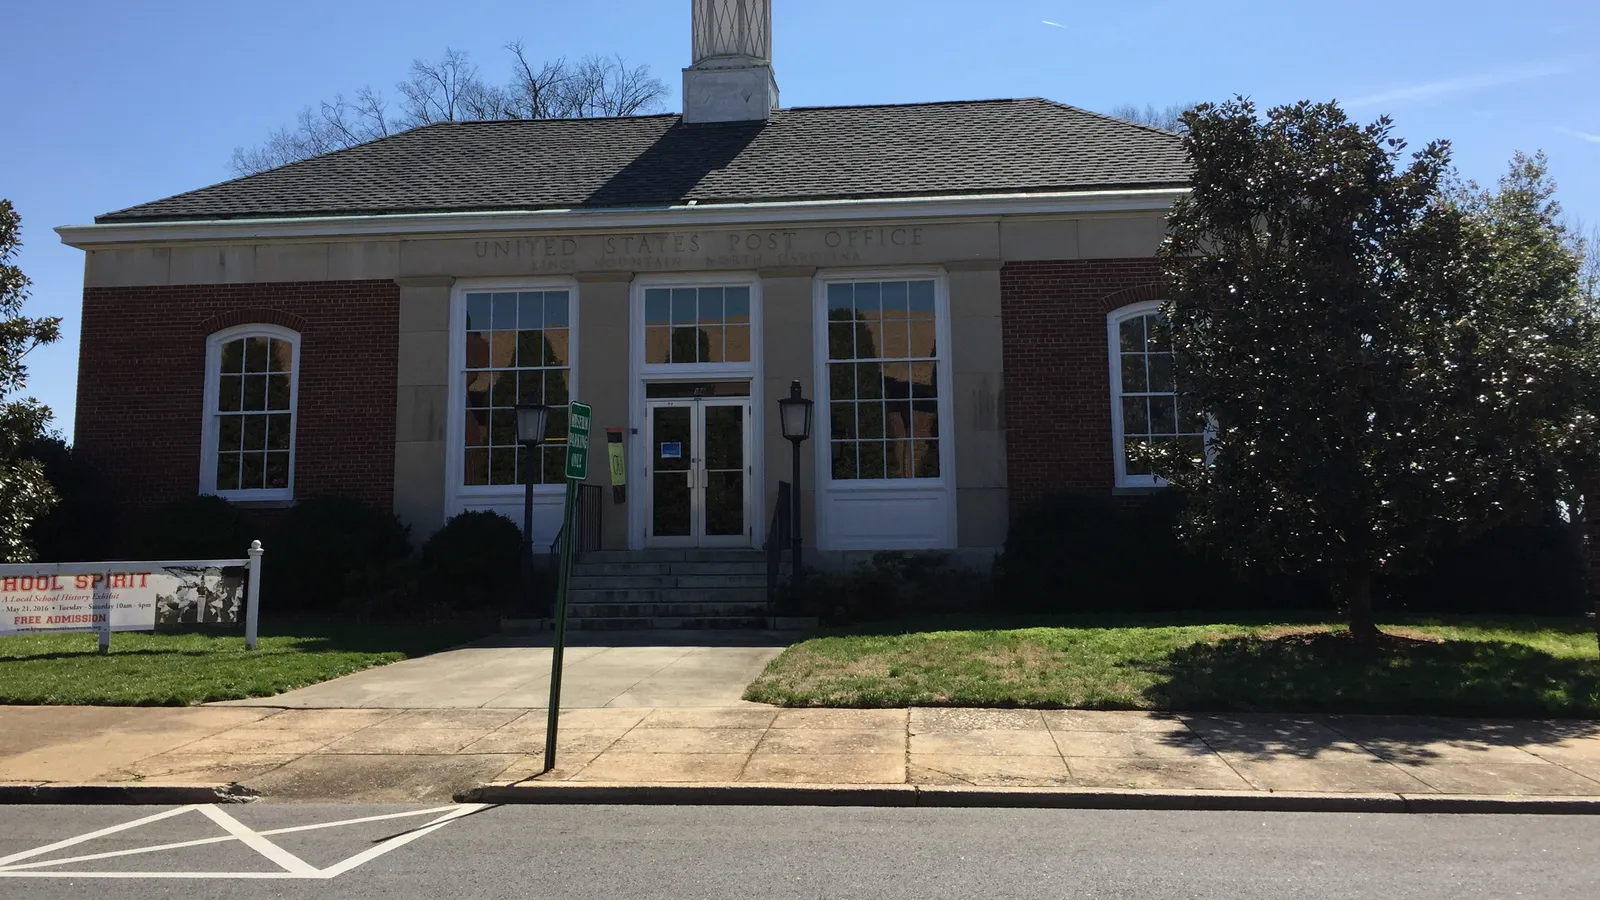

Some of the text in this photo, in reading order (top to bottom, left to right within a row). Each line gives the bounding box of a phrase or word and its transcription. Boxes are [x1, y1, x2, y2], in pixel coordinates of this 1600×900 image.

[475, 228, 924, 258] UNITED STATES POST OFFICE
[532, 259, 577, 271] KINGS
[706, 254, 762, 265] NORTH
[75, 572, 151, 589] SPIRIT
[1, 591, 119, 603] A Local School History Exhibit
[59, 604, 82, 612] Tuesday
[88, 603, 114, 611] Saturday
[14, 614, 107, 624] FREE ADMISSION
